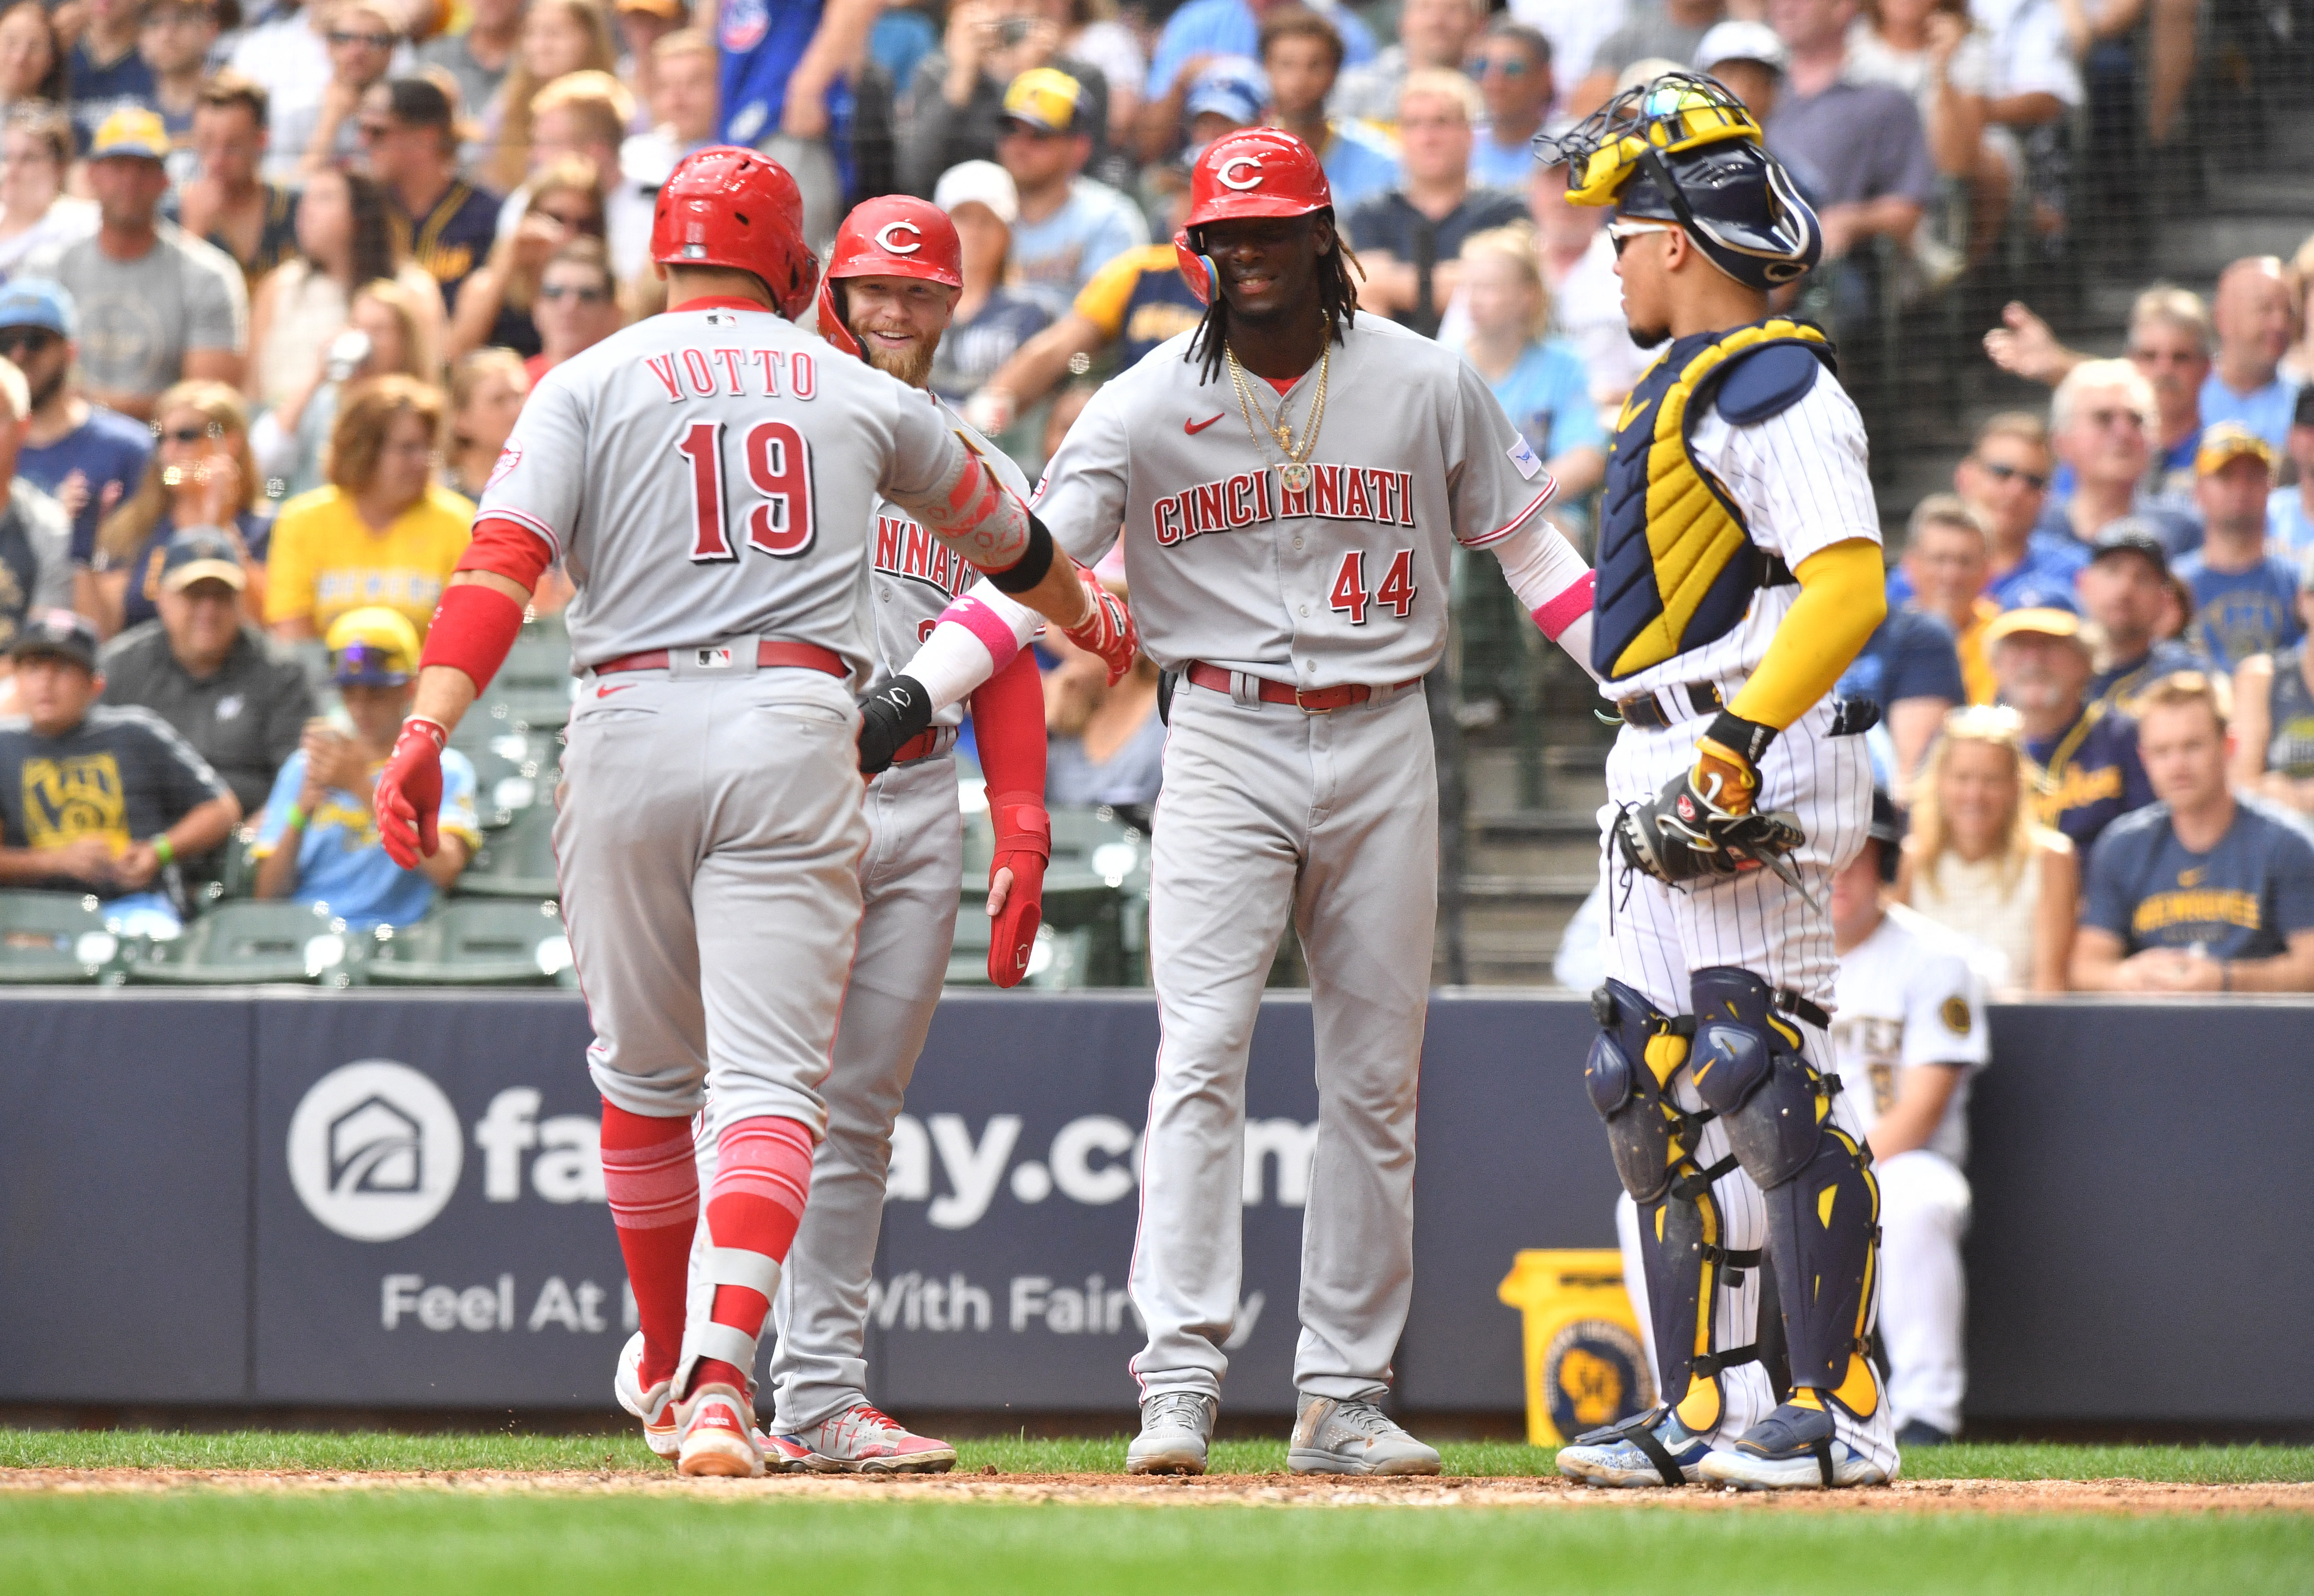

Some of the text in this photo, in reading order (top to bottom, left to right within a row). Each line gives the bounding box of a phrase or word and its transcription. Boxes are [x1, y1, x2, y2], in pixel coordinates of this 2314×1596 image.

[1216, 157, 1263, 190] C
[874, 221, 921, 253] C
[642, 347, 817, 404] VOTTO
[672, 418, 817, 564] 19
[1153, 463, 1416, 547] CINCINNATI
[1328, 548, 1418, 626] 44
[381, 1273, 515, 1331] Feel
[529, 1275, 607, 1331] At
[1009, 1274, 1265, 1349] Fairy
